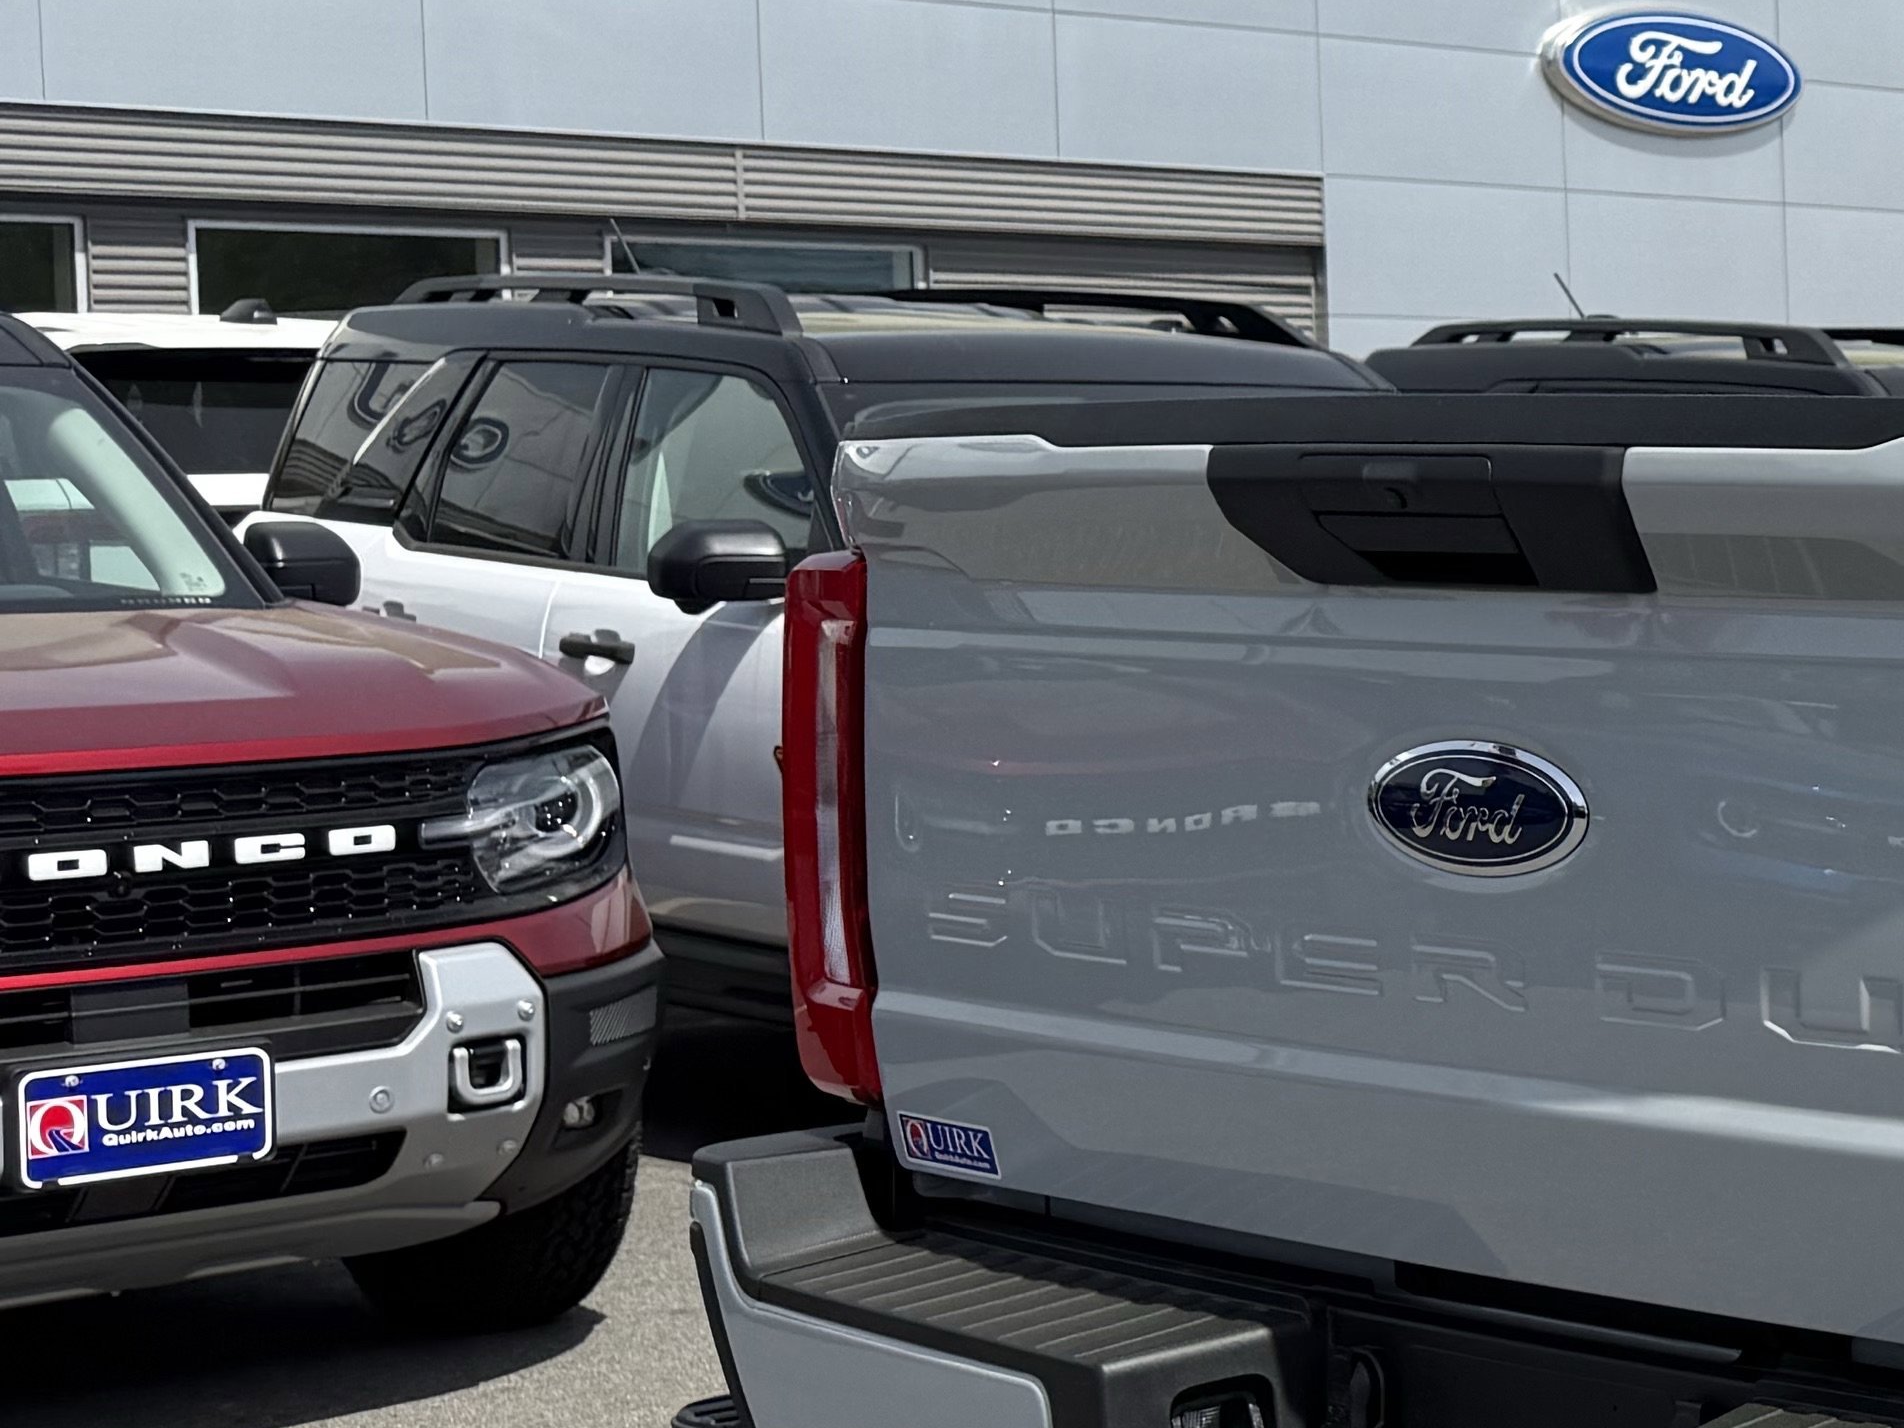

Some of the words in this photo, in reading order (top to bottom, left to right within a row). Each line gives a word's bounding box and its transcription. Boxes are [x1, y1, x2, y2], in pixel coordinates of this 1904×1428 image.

[1616, 30, 1757, 108] Ford
[1410, 768, 1525, 844] Ford
[927, 885, 1528, 1013] SUPER
[29, 1076, 263, 1155] QUIRK
[102, 1118, 255, 1147] QuirkAuto.com
[906, 1119, 990, 1160] QUIRK
